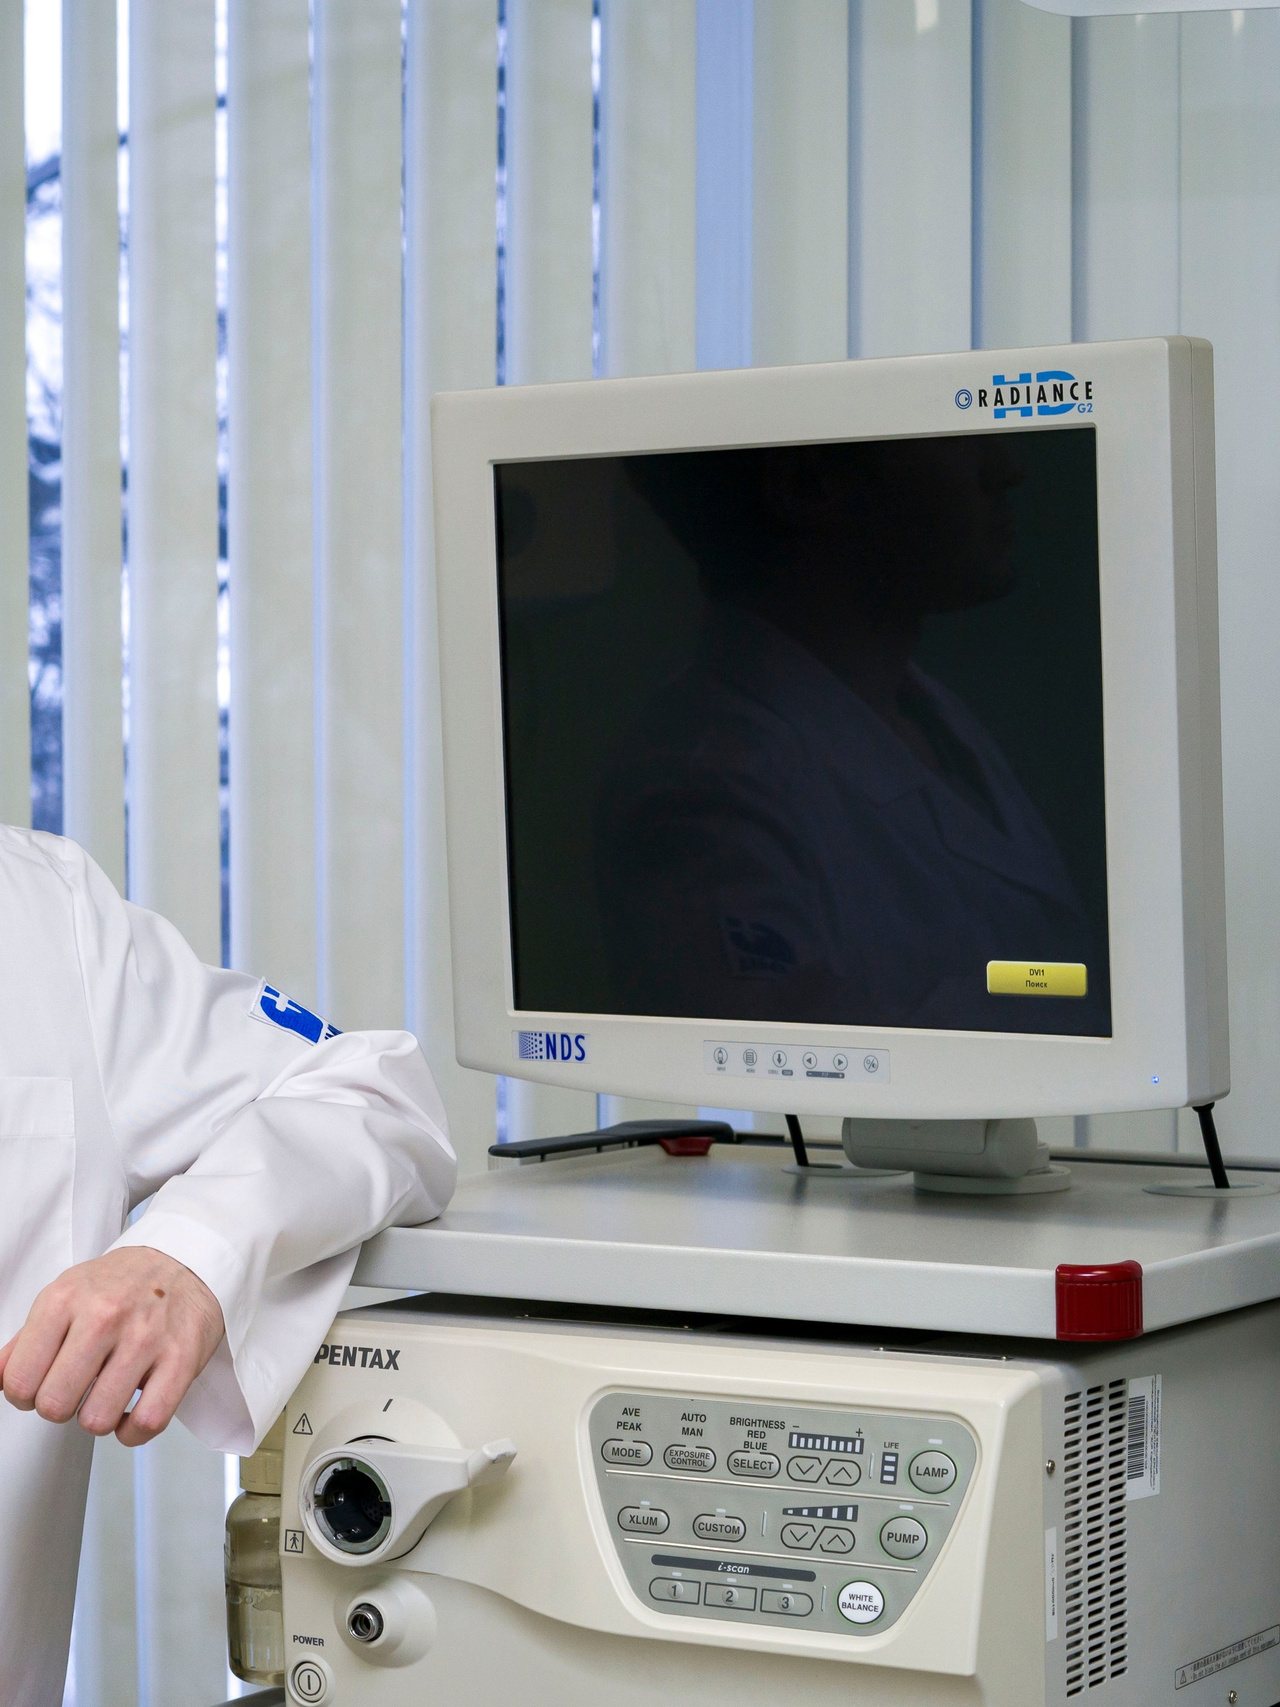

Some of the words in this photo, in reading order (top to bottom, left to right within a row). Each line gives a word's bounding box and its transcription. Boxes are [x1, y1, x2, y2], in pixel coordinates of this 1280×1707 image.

[978, 381, 1093, 408] RADIANCE
[1077, 403, 1093, 413] G2
[1026, 980, 1048, 988] Поиск
[545, 1033, 586, 1061] NDS
[313, 1343, 401, 1371] PENTAX
[621, 1407, 640, 1417] AVE
[680, 1412, 707, 1423] AUTO
[616, 1421, 642, 1432] PEAK
[729, 1416, 786, 1430] BRIGHTNESS
[681, 1426, 704, 1437] MAN
[747, 1430, 766, 1439] RED
[743, 1440, 768, 1450] BLUE
[883, 1441, 900, 1449] LIFE
[611, 1446, 642, 1459] MODE
[669, 1449, 711, 1460] EXPOSURE
[670, 1457, 708, 1468] CONTROL
[733, 1458, 774, 1471] SELECT
[915, 1466, 949, 1478] LAMP
[628, 1514, 658, 1527] XLUM
[698, 1522, 741, 1535] CUSTOM
[886, 1532, 919, 1544] PUMP
[717, 1562, 750, 1574] i-scan
[671, 1584, 677, 1596] 1
[725, 1590, 734, 1602] 2
[781, 1596, 790, 1609] 3
[848, 1593, 874, 1603] WHITE
[841, 1602, 879, 1613] BALANCE
[292, 1634, 325, 1647] POWER
